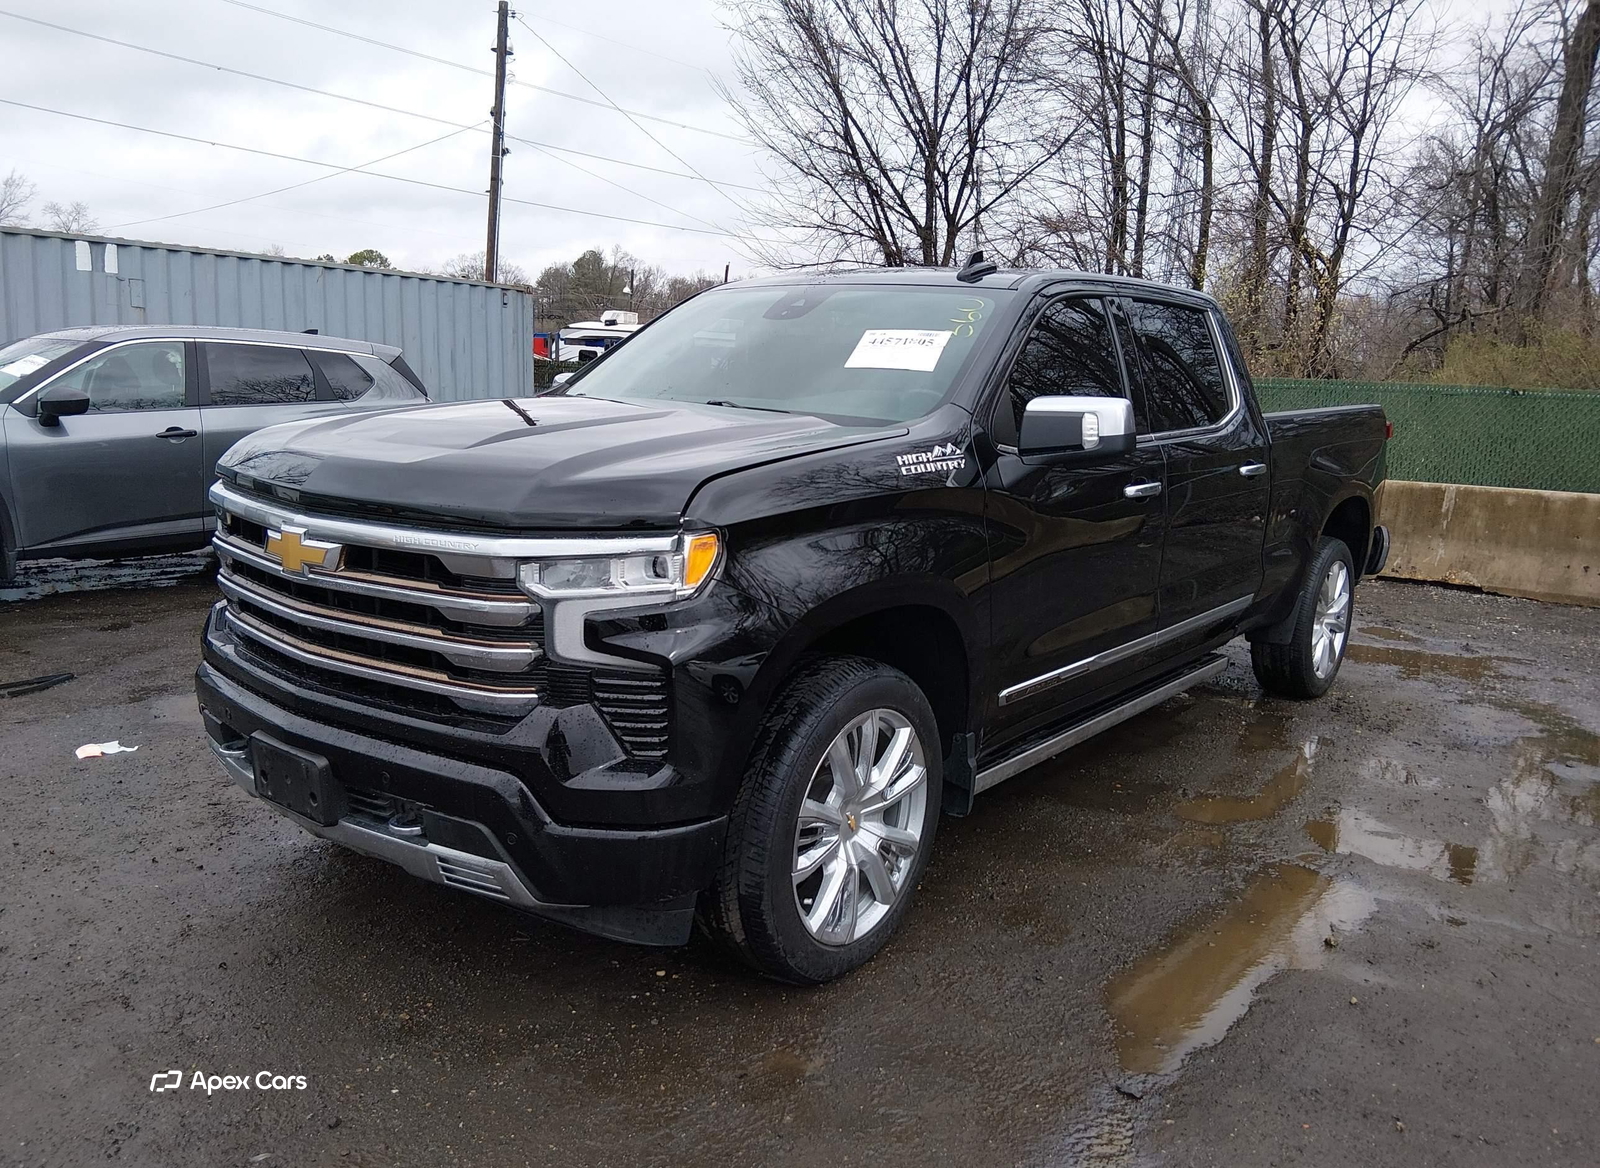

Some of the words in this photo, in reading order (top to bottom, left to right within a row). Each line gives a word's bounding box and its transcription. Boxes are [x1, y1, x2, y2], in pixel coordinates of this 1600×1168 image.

[896, 452, 932, 465] HIGH
[901, 459, 965, 475] COUNTRY
[393, 535, 420, 545] HIGH
[423, 538, 480, 550] COUNTRY
